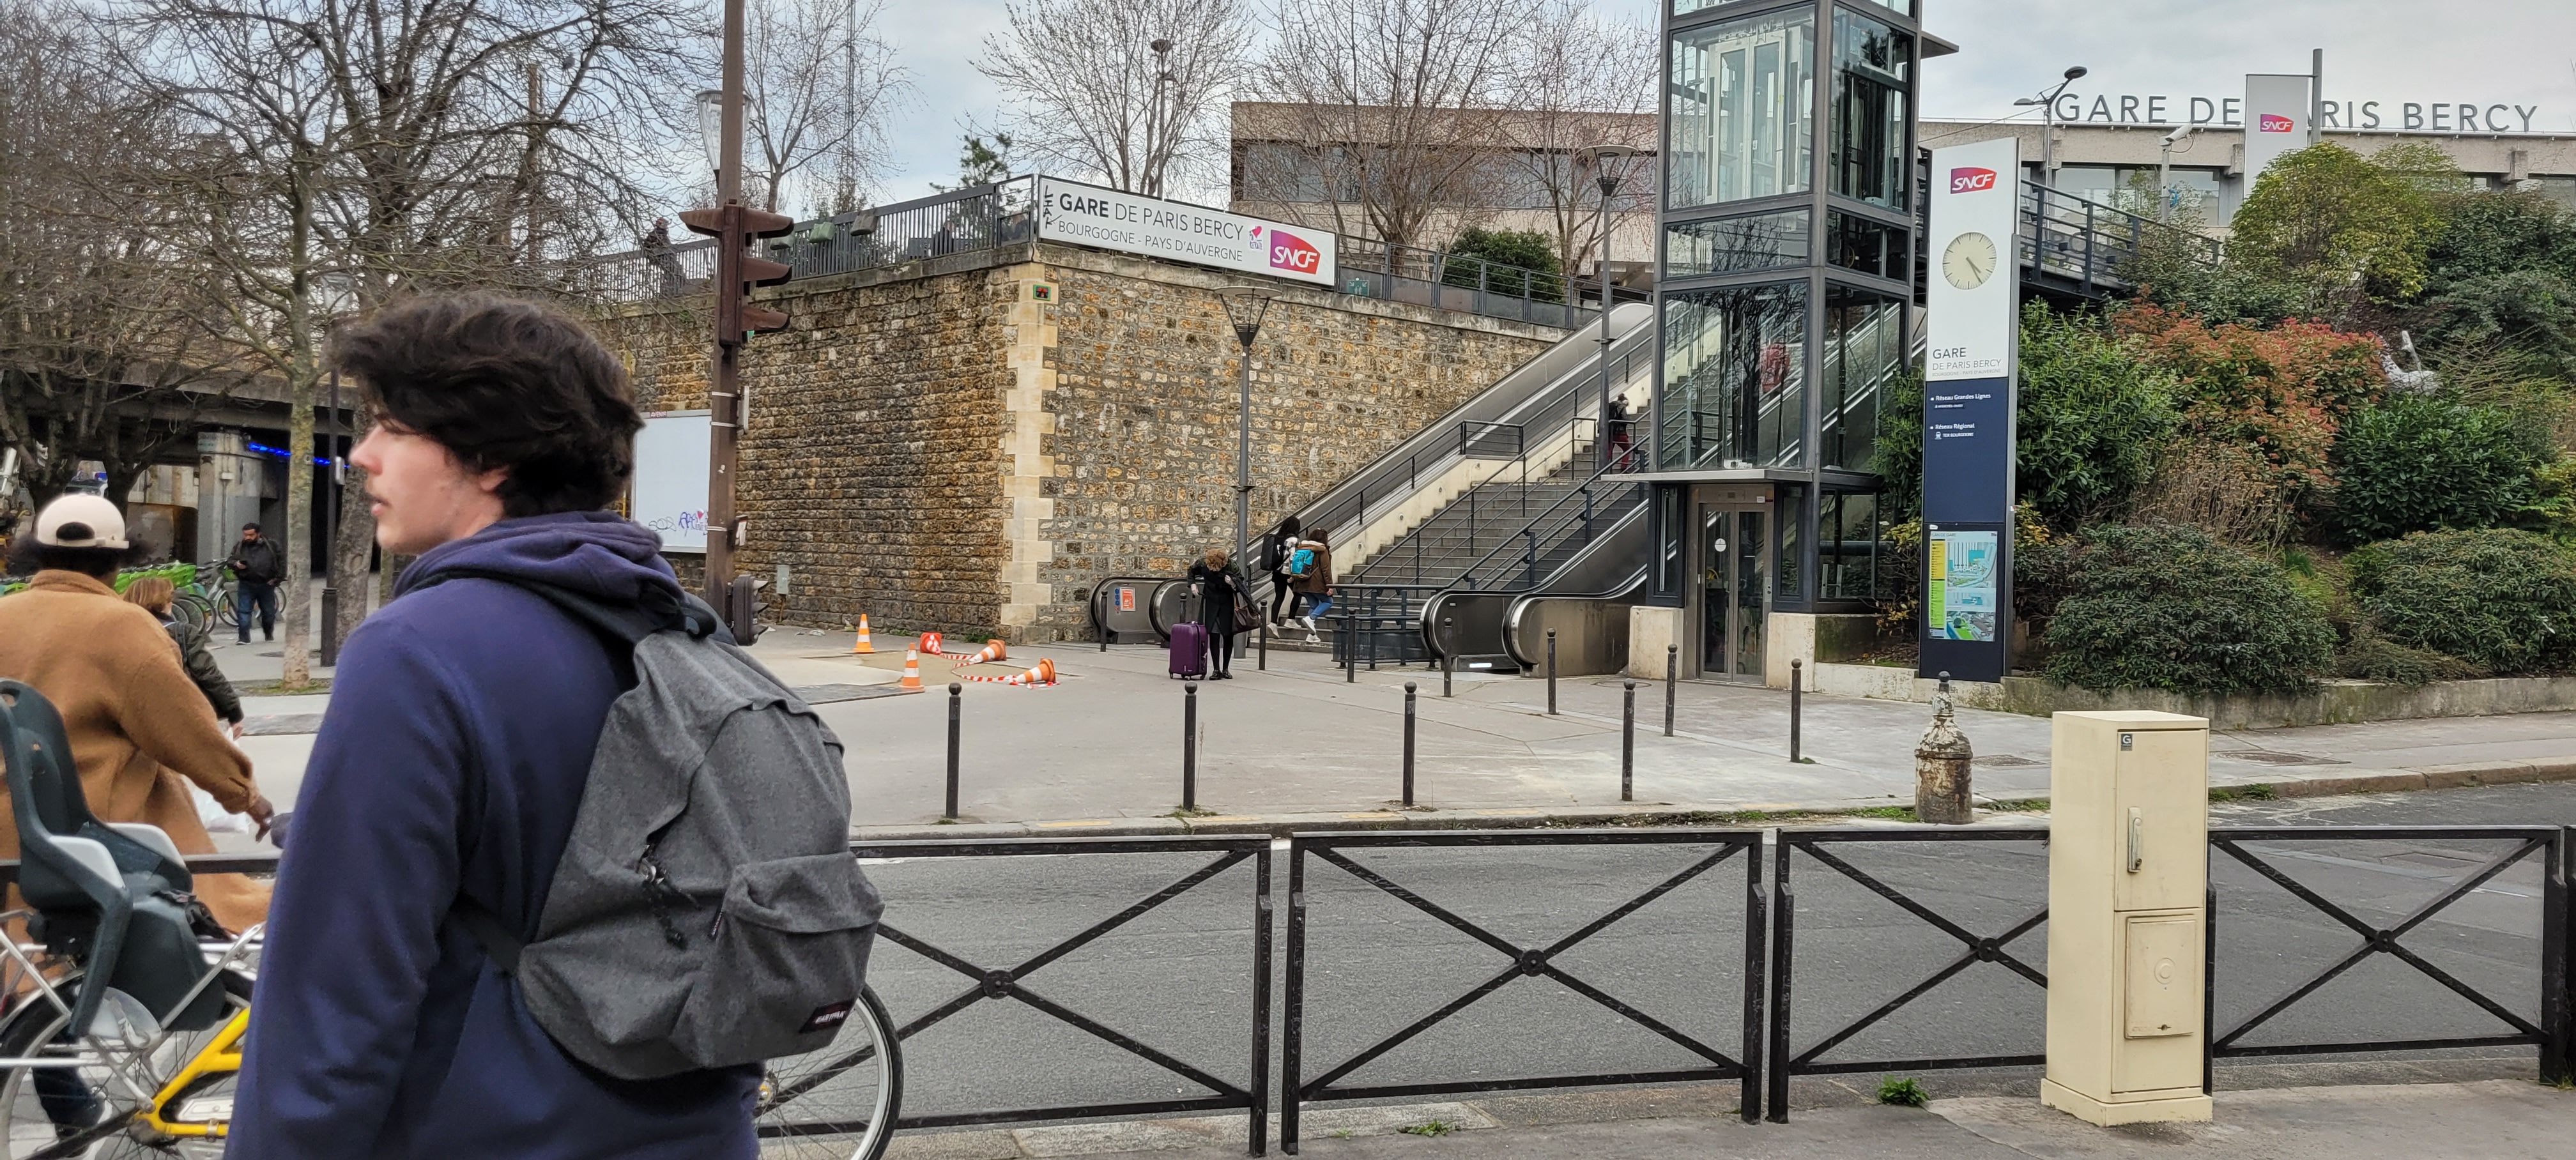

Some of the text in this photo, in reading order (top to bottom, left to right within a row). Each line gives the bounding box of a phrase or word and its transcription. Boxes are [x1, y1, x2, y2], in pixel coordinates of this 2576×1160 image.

[2055, 93, 2539, 133] GARE DE RIS BERCY
[2261, 121, 2292, 130] SNCF
[1952, 172, 1994, 191] SNCF
[1060, 193, 1244, 241] GARE DE PARIS BERCY
[1059, 220, 1135, 244] BOURGOGNE
[1145, 235, 1172, 250] PAYS
[1176, 240, 1243, 262] D'AUVERGNE
[1271, 245, 1318, 269] SNCF
[1933, 347, 1966, 359] GARE
[1933, 358, 2002, 370] DE PARIS BERCY
[2122, 735, 2131, 744] G
